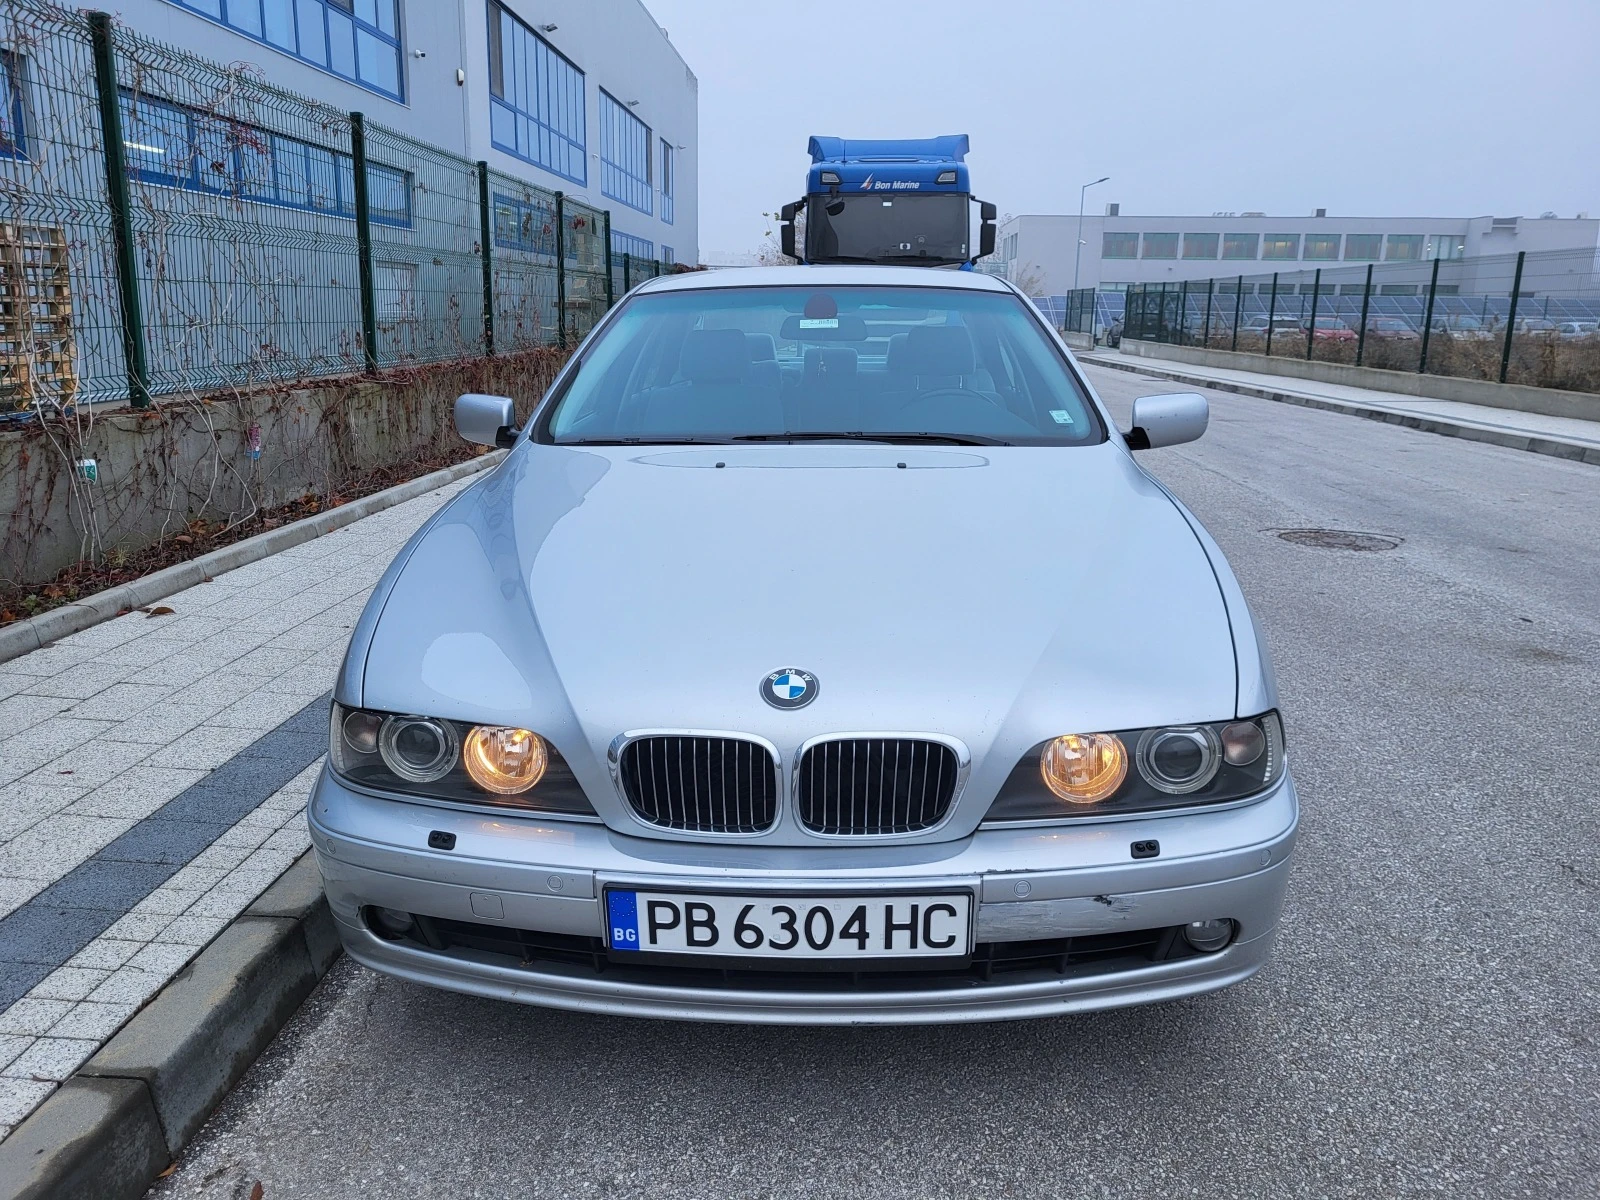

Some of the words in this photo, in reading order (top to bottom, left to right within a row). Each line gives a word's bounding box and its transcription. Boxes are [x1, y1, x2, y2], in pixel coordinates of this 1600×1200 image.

[875, 181, 891, 190] Bon
[892, 181, 920, 190] Marine
[769, 669, 813, 681] BMW
[646, 899, 719, 947] PB
[733, 904, 870, 950] 6304
[884, 903, 957, 949] HC
[613, 927, 636, 942] BG
